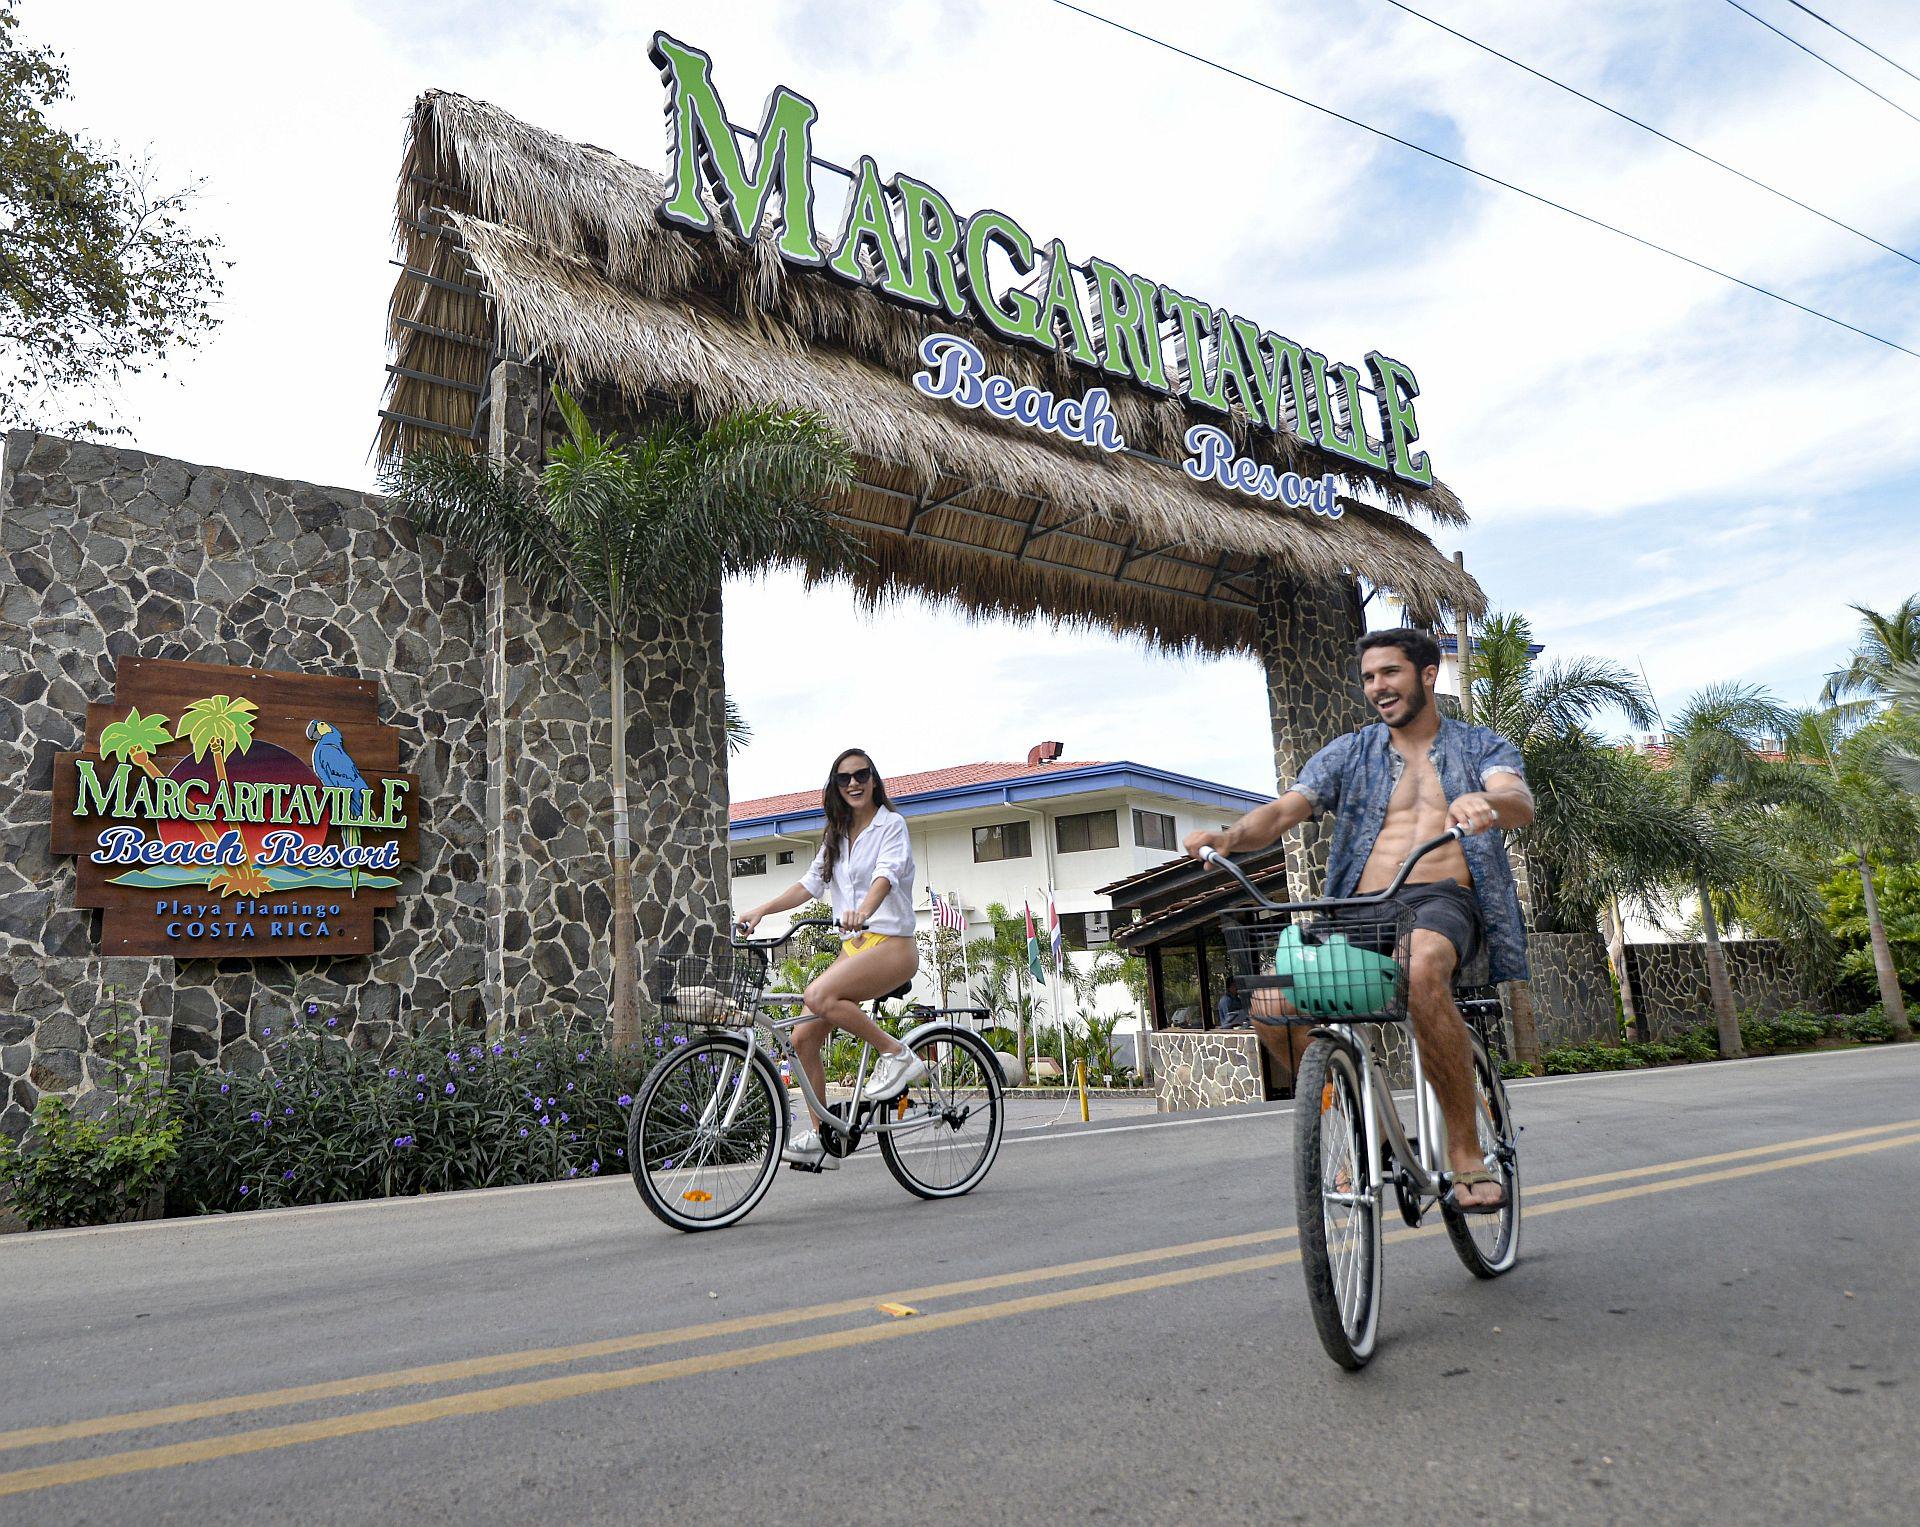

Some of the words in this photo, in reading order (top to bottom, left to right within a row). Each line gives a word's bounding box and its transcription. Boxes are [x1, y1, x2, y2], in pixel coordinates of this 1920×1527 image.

[650, 30, 1433, 489] MARGARITAVILLE
[913, 333, 1125, 453] Beach
[1183, 425, 1345, 519] Resort
[73, 760, 409, 828] MARGARITAVILLE
[90, 826, 246, 866] Beach
[257, 830, 401, 870] Resort
[156, 901, 222, 918] Playa
[236, 901, 341, 918] Flamingo
[166, 922, 255, 938] COSTA
[271, 921, 330, 937] RICA
